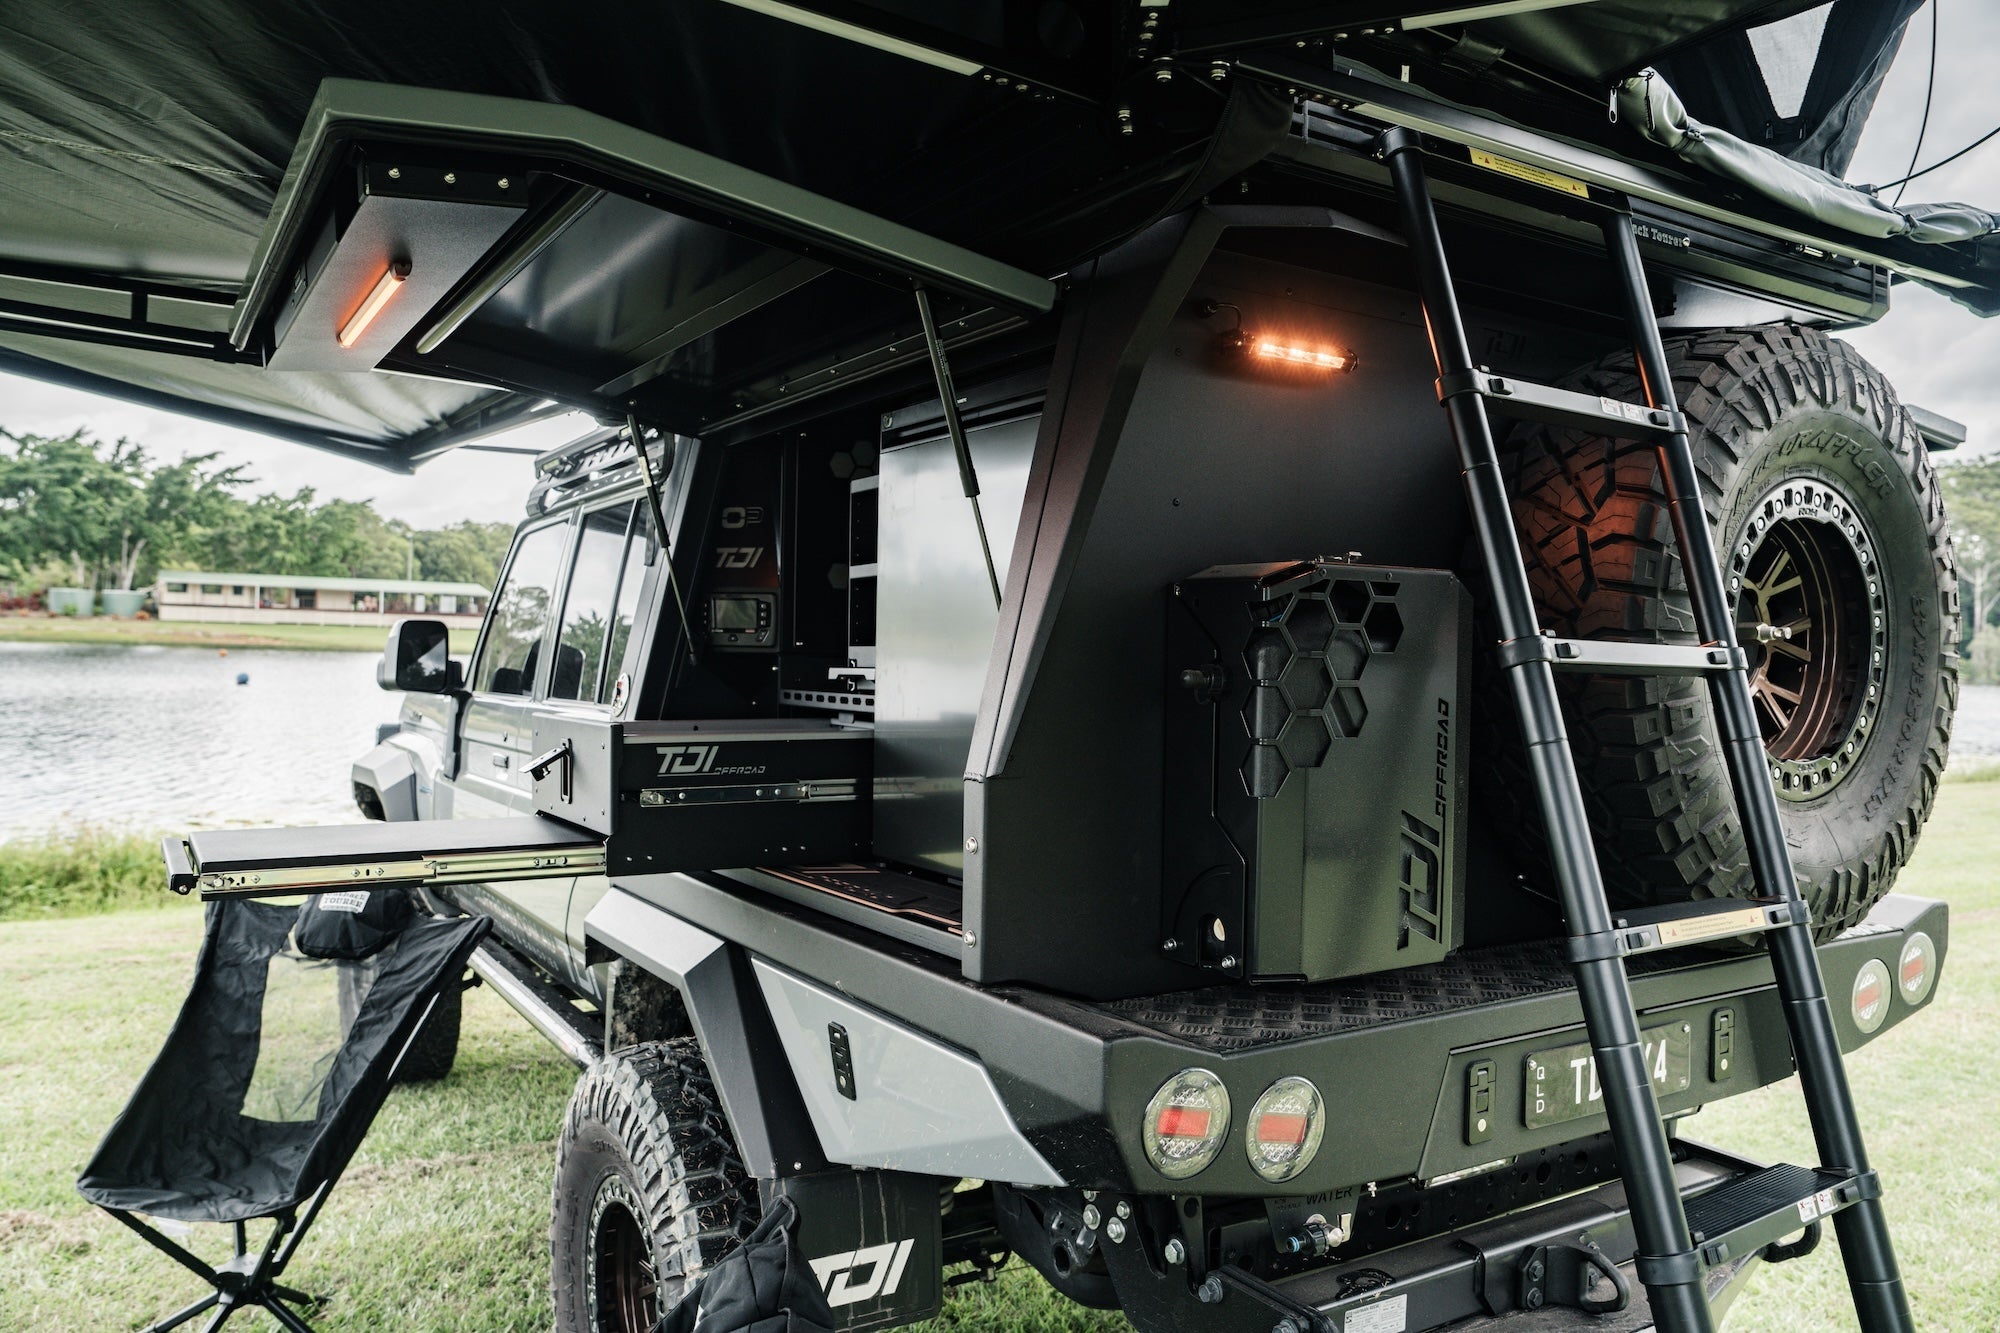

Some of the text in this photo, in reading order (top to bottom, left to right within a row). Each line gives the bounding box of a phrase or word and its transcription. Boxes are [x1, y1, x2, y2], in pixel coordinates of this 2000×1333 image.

[716, 546, 765, 569] TDI
[656, 745, 767, 776] TDI OFFROAD
[1396, 698, 1450, 951] TDI OFFROAD
[1306, 1186, 1353, 1205] WATER
[807, 1238, 915, 1308] TDI
